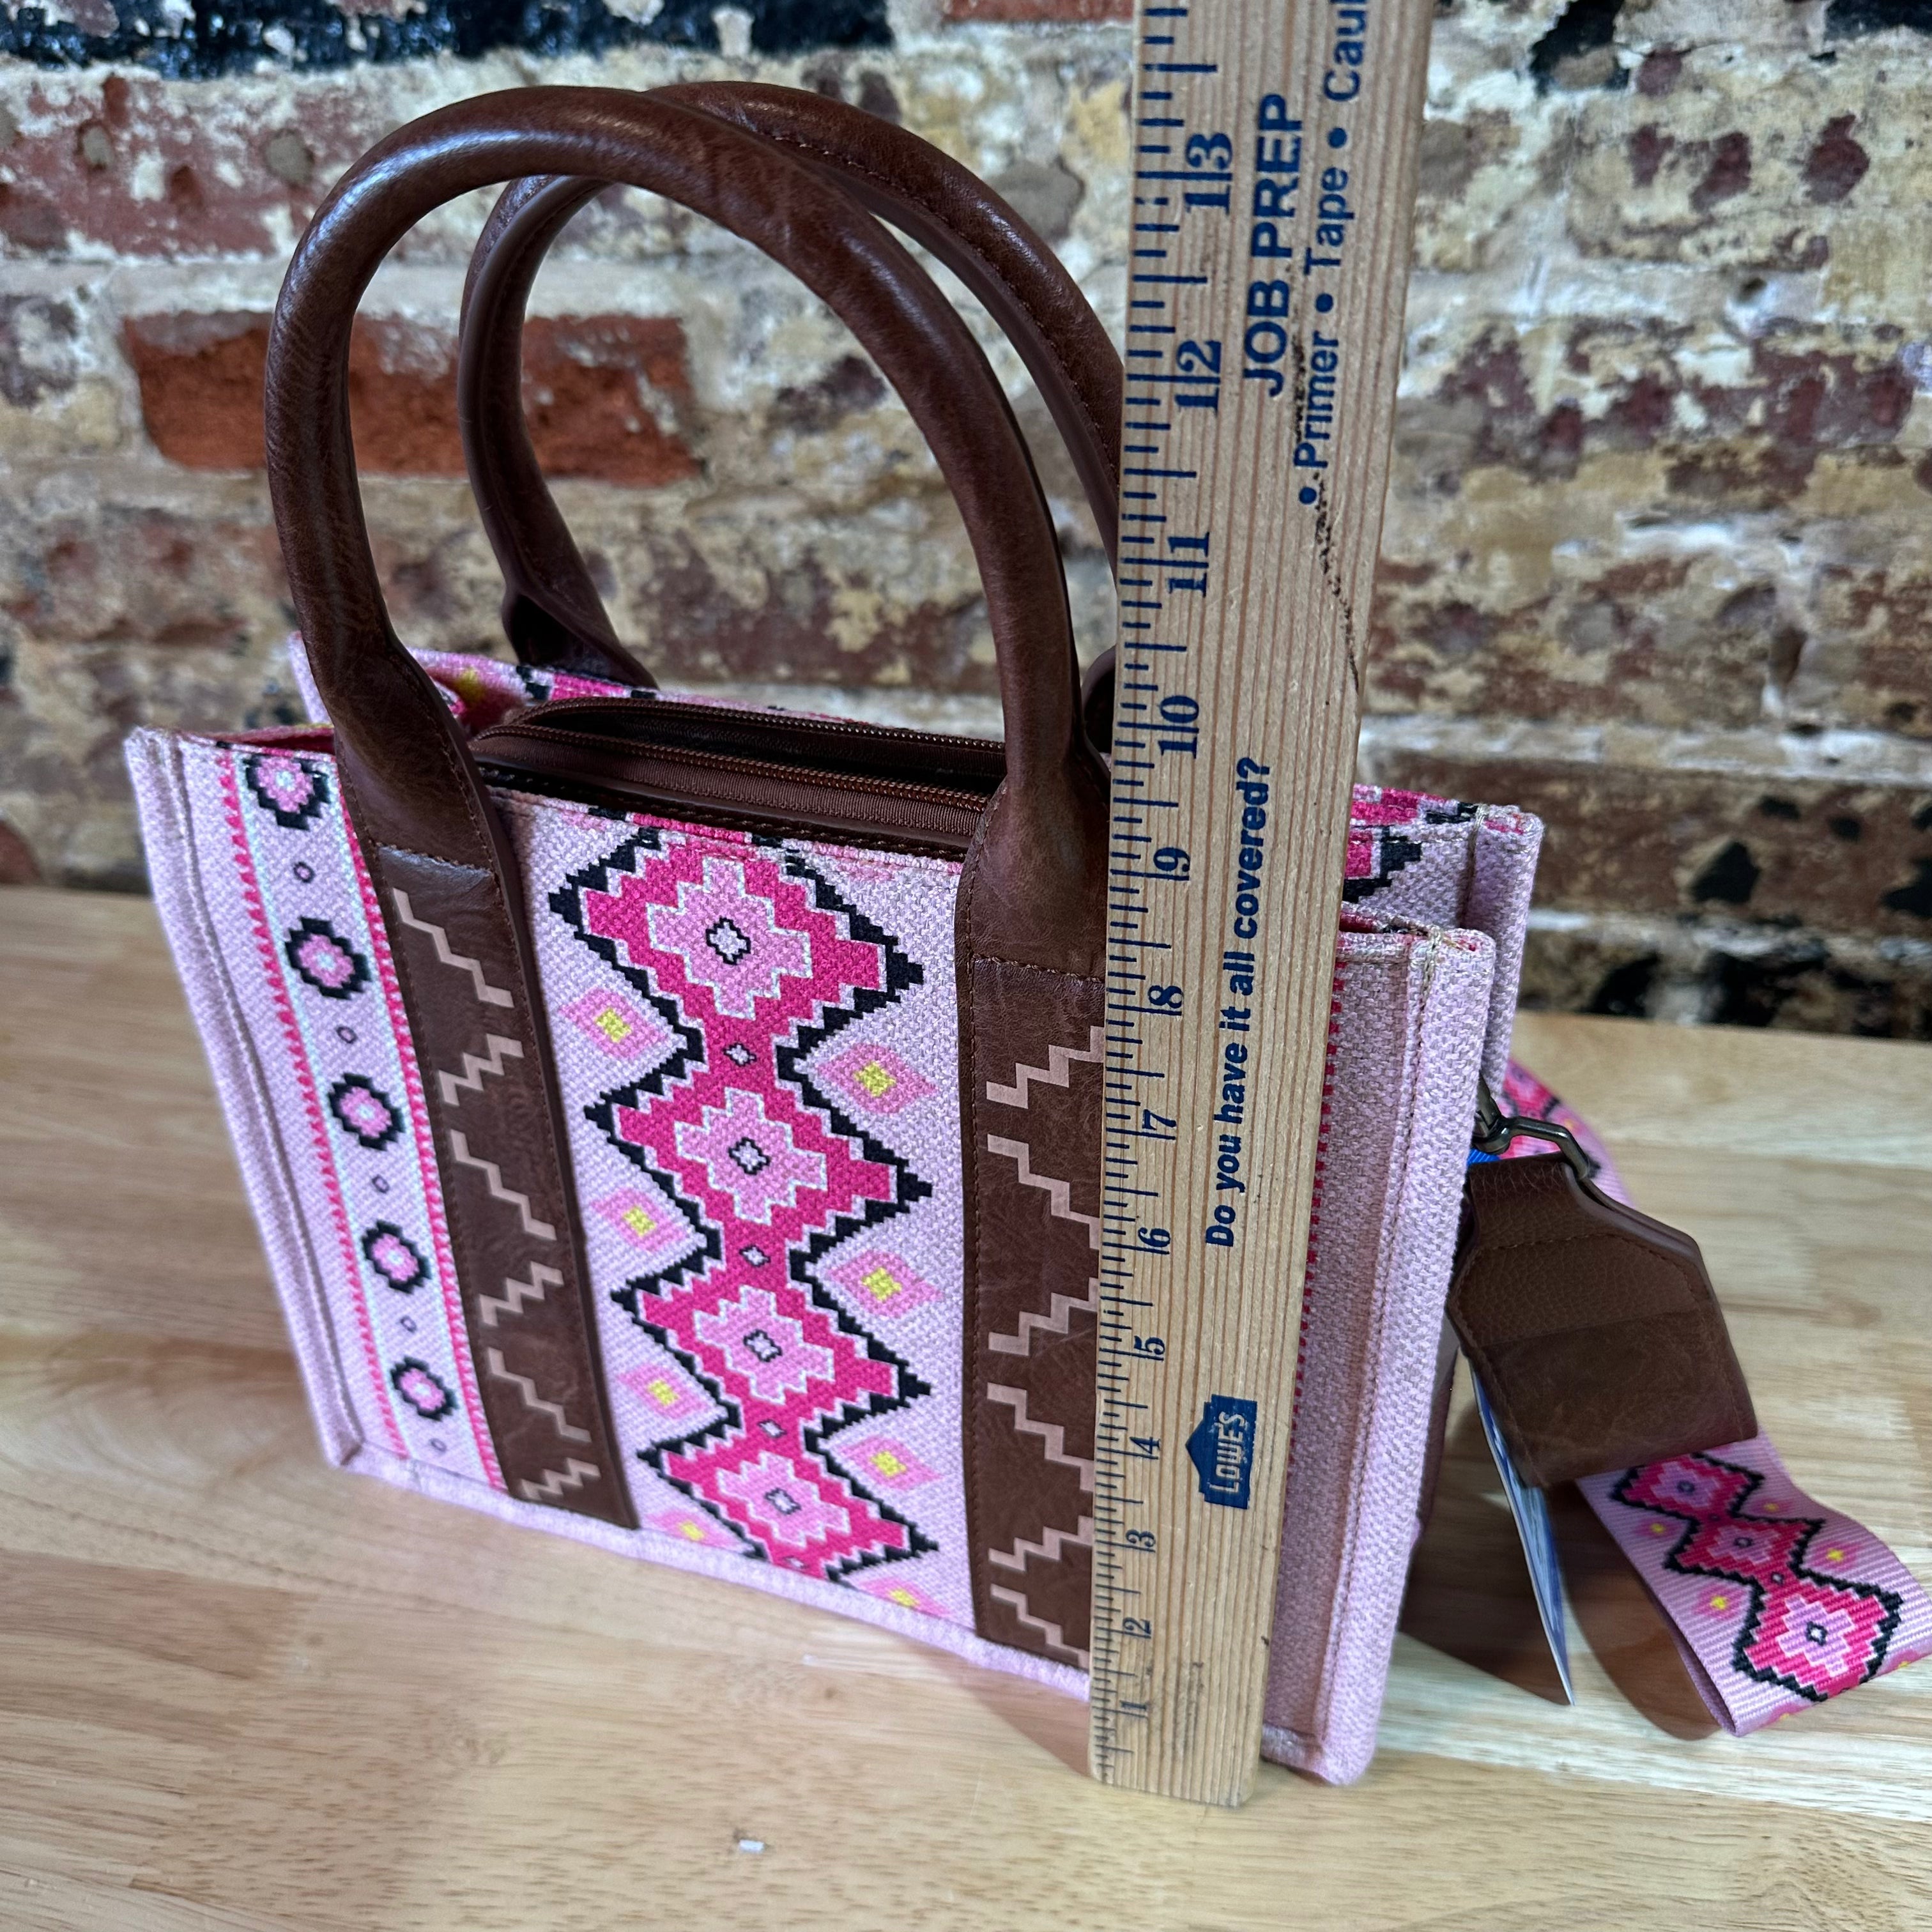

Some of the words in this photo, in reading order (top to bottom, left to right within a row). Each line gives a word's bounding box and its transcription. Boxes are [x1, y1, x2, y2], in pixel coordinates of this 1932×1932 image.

[1184, 132, 1232, 215] 13
[1251, 93, 1302, 257] PREP
[1304, 167, 1354, 275] Tape
[1243, 280, 1289, 398] JOB
[1174, 340, 1222, 417] 12
[1294, 331, 1339, 468] Primer
[1167, 532, 1209, 597] 11
[1157, 695, 1199, 759] 10
[1153, 847, 1191, 873] 9
[1233, 757, 1271, 939] covered?
[1147, 985, 1184, 1009] 8
[1223, 951, 1255, 996] all
[1218, 1006, 1252, 1032] it
[1213, 1042, 1248, 1124] have
[1142, 1109, 1177, 1131] 7
[1216, 1134, 1245, 1194] you
[1138, 1226, 1171, 1248] 6
[1205, 1204, 1236, 1247] Do
[1133, 1335, 1166, 1355] 5
[1130, 1436, 1162, 1455] 4
[1125, 1529, 1157, 1547] 3
[1122, 1616, 1152, 1635] 2
